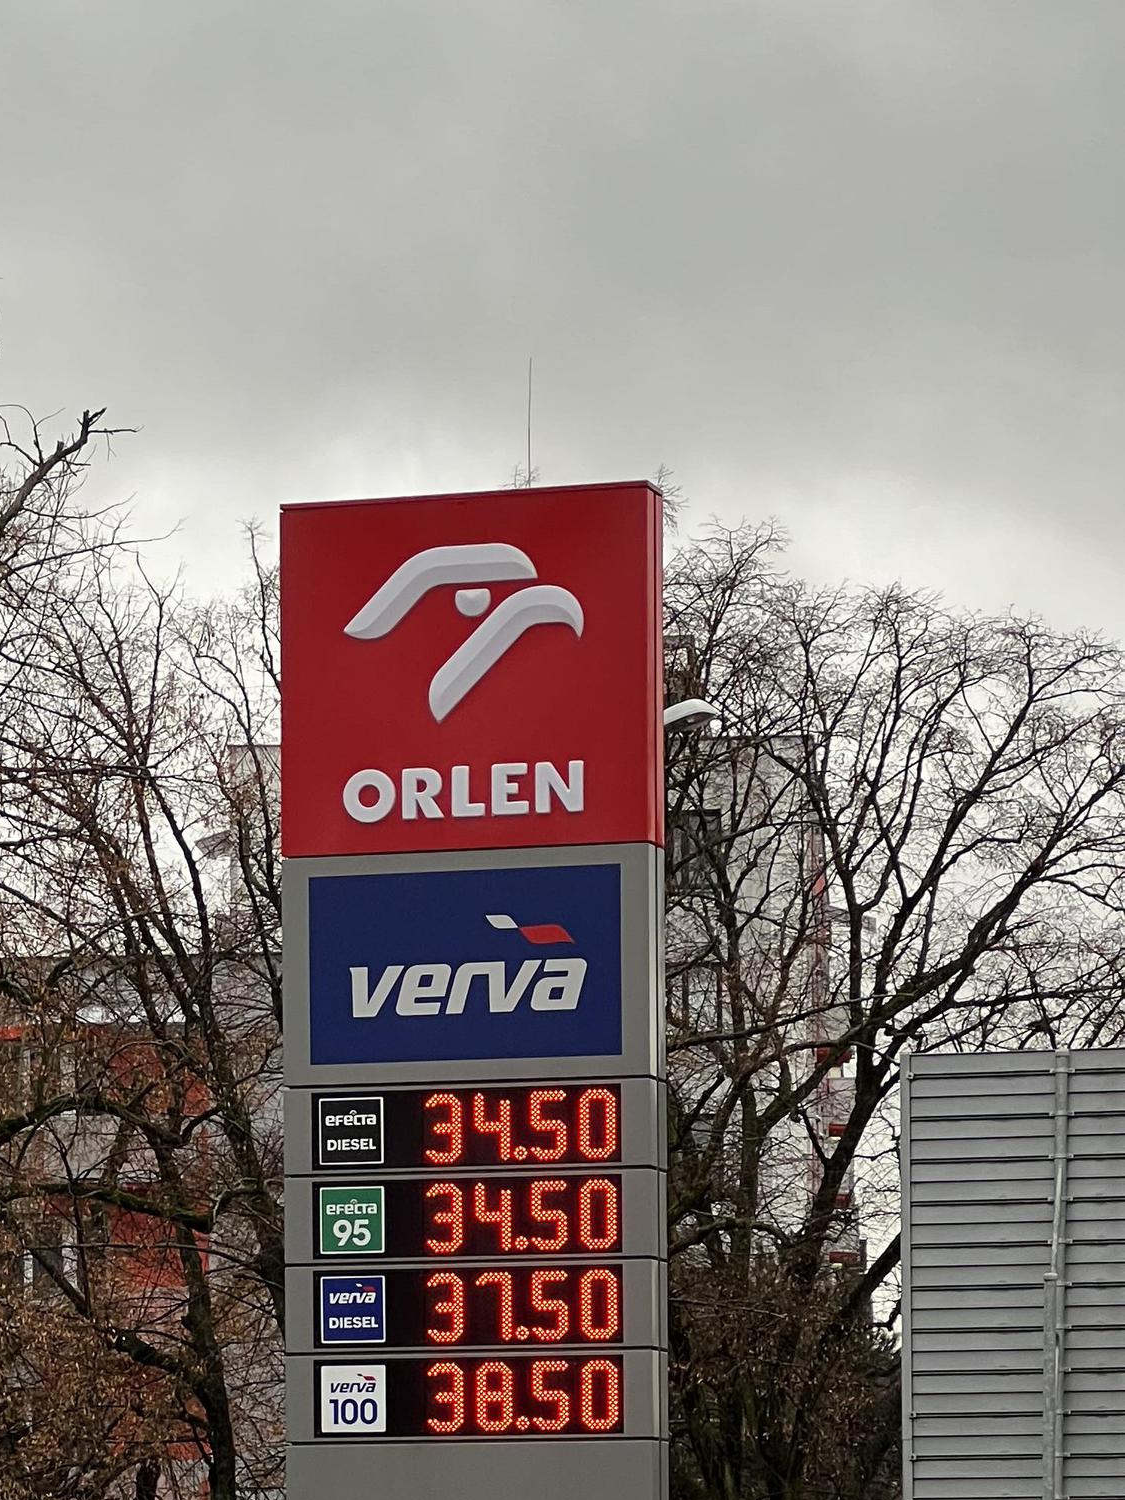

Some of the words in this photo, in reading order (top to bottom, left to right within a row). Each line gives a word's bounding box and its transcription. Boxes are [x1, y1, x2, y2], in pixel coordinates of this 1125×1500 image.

[343, 760, 584, 823] ORLEN
[349, 957, 588, 1018] verva
[327, 1138, 376, 1151] DIESEL
[425, 1088, 617, 1163] 34.50
[333, 1219, 371, 1246] 95
[426, 1179, 618, 1253] 34.50
[329, 1292, 376, 1304] verva
[427, 1269, 618, 1342] 37.50
[329, 1317, 378, 1329] DIESEL
[330, 1383, 376, 1393] verva
[427, 1360, 619, 1432] 38.50
[329, 1399, 378, 1425] 100
